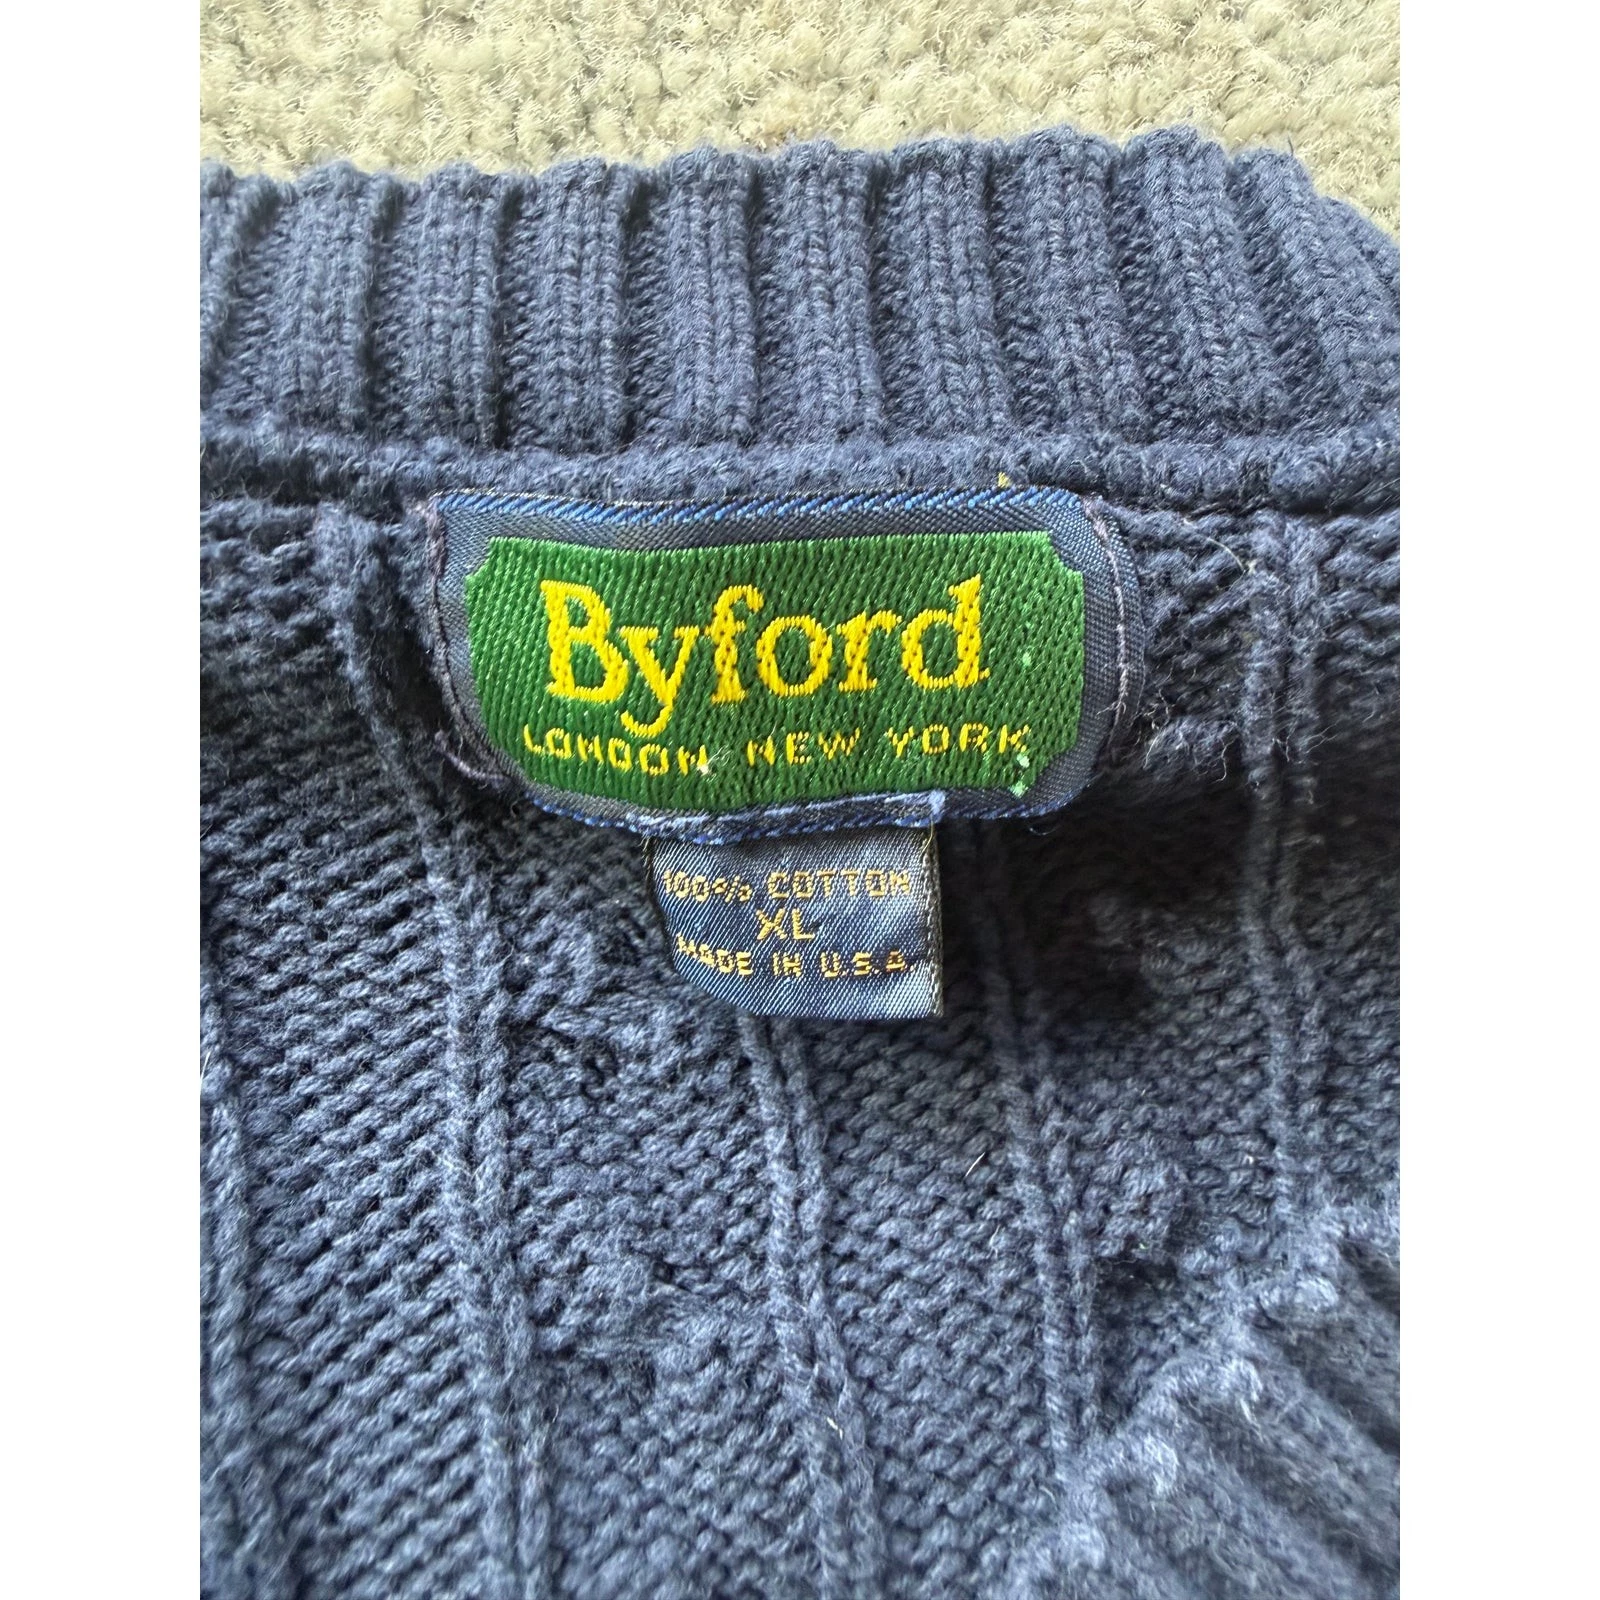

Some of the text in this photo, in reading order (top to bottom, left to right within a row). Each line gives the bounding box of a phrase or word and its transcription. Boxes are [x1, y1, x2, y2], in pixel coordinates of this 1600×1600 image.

[540, 574, 990, 738] Byford
[523, 722, 1030, 776] LONDON NEW YORK
[662, 868, 911, 902] 100% COTTON
[757, 908, 815, 940] XL
[676, 932, 753, 975] MADE
[773, 951, 802, 976] IN
